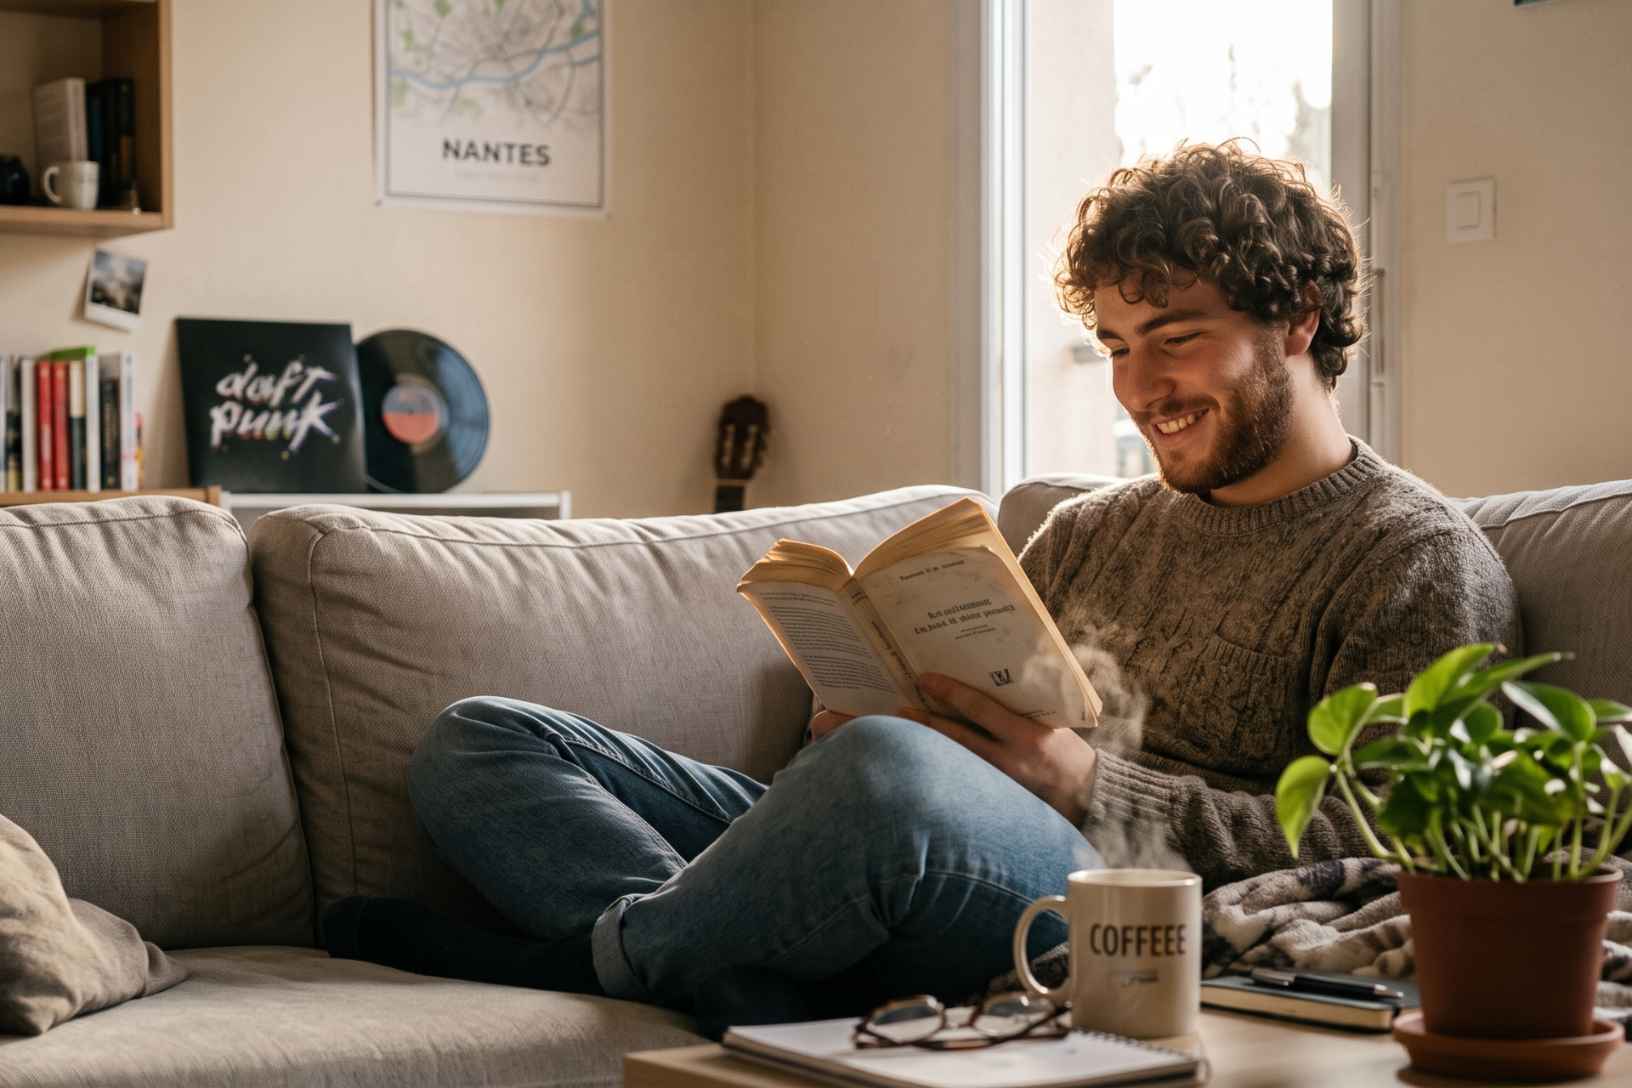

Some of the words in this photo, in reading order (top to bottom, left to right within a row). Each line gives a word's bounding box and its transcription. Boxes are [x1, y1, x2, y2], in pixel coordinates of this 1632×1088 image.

[442, 138, 551, 166] NANTES
[216, 359, 336, 407] daft
[210, 391, 340, 450] punk
[1090, 922, 1187, 957] COFFEEE
